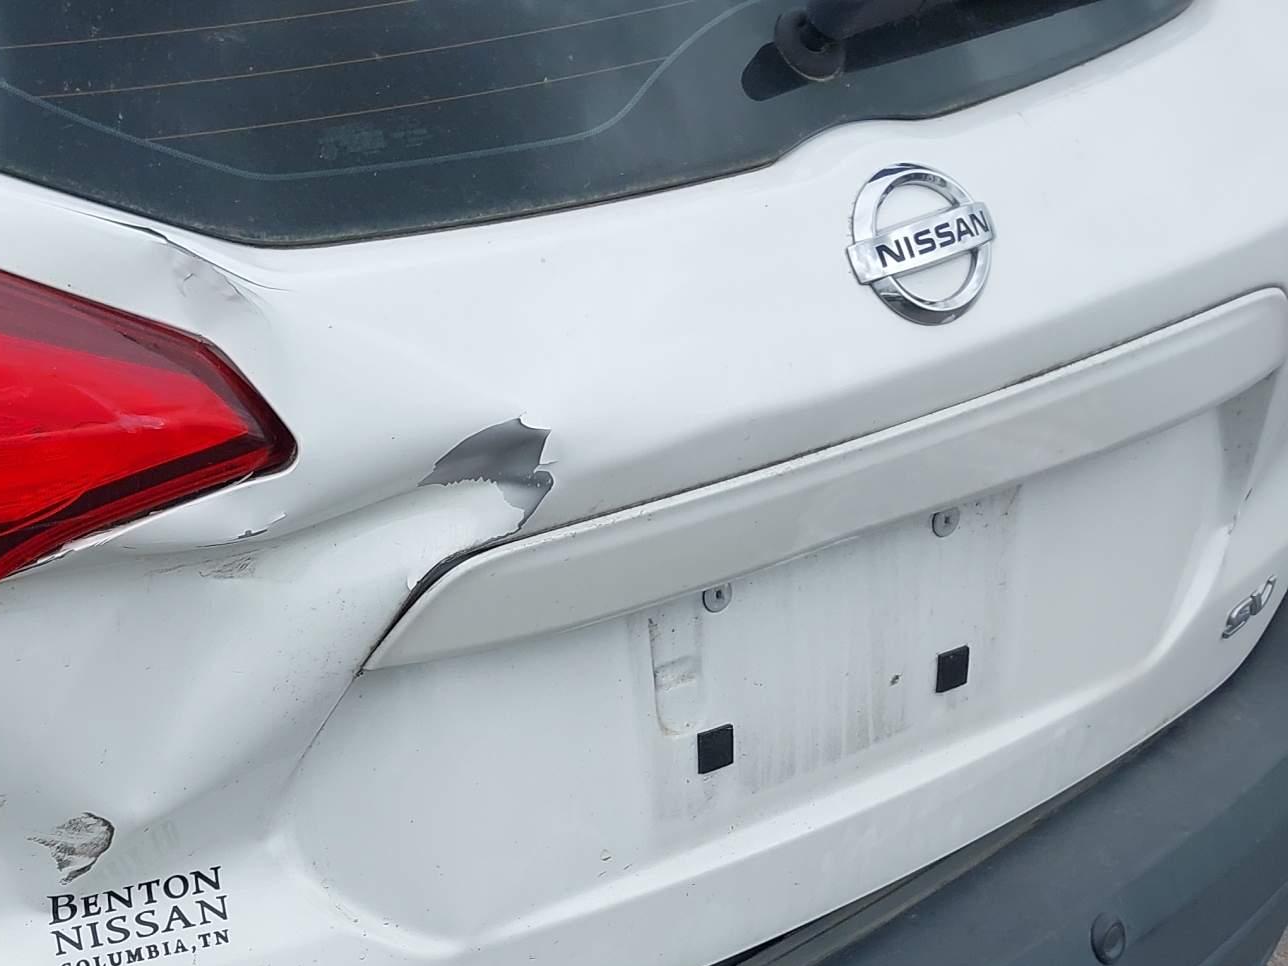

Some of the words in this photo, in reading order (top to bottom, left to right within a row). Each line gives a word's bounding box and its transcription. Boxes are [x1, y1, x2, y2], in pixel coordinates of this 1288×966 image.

[875, 211, 990, 268] NISSAN
[1222, 574, 1277, 639] SV
[48, 866, 221, 925] BENTON
[50, 896, 228, 956] NISSAN
